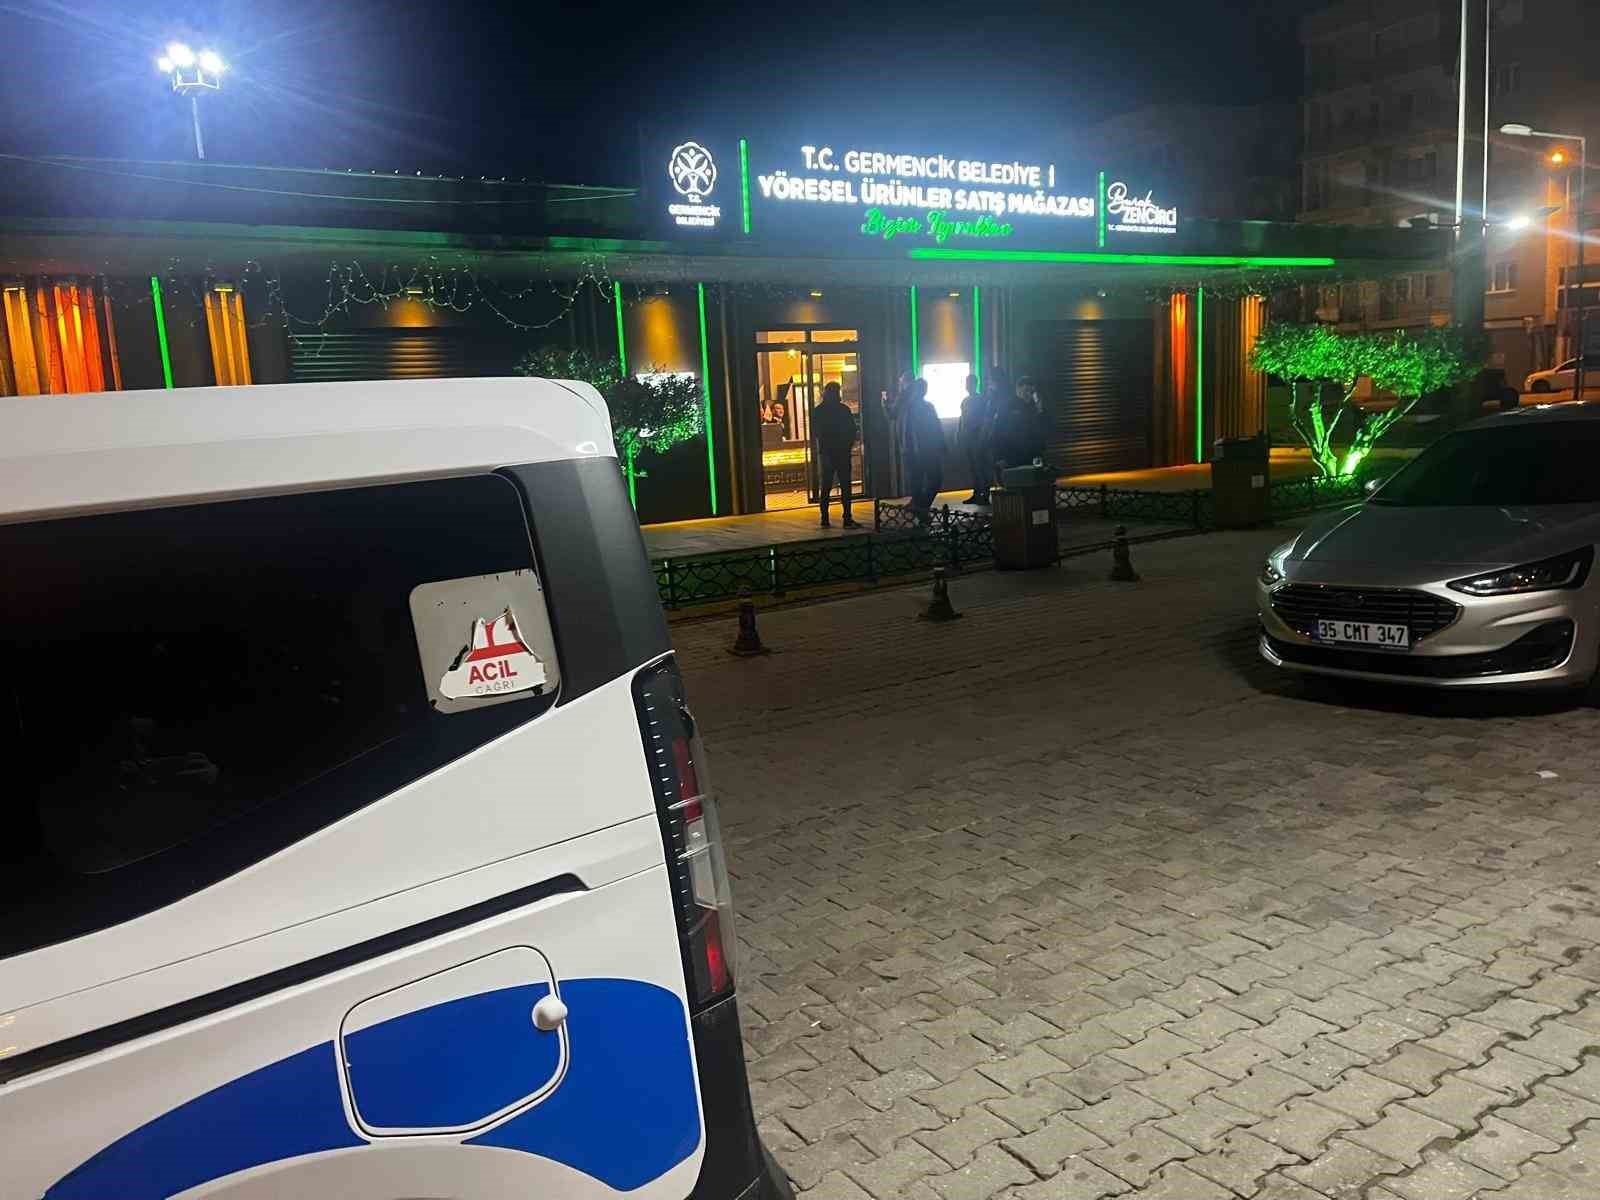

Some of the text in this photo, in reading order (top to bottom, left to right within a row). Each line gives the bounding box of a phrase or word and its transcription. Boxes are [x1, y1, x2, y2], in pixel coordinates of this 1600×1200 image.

[801, 145, 839, 172] T.C.
[844, 150, 956, 180] GERMENCİK
[758, 170, 1095, 217] YÖRESEL ÜRÜNLER SATIŞ MAĞAZASI
[1320, 622, 1405, 644] 35 CMT 347
